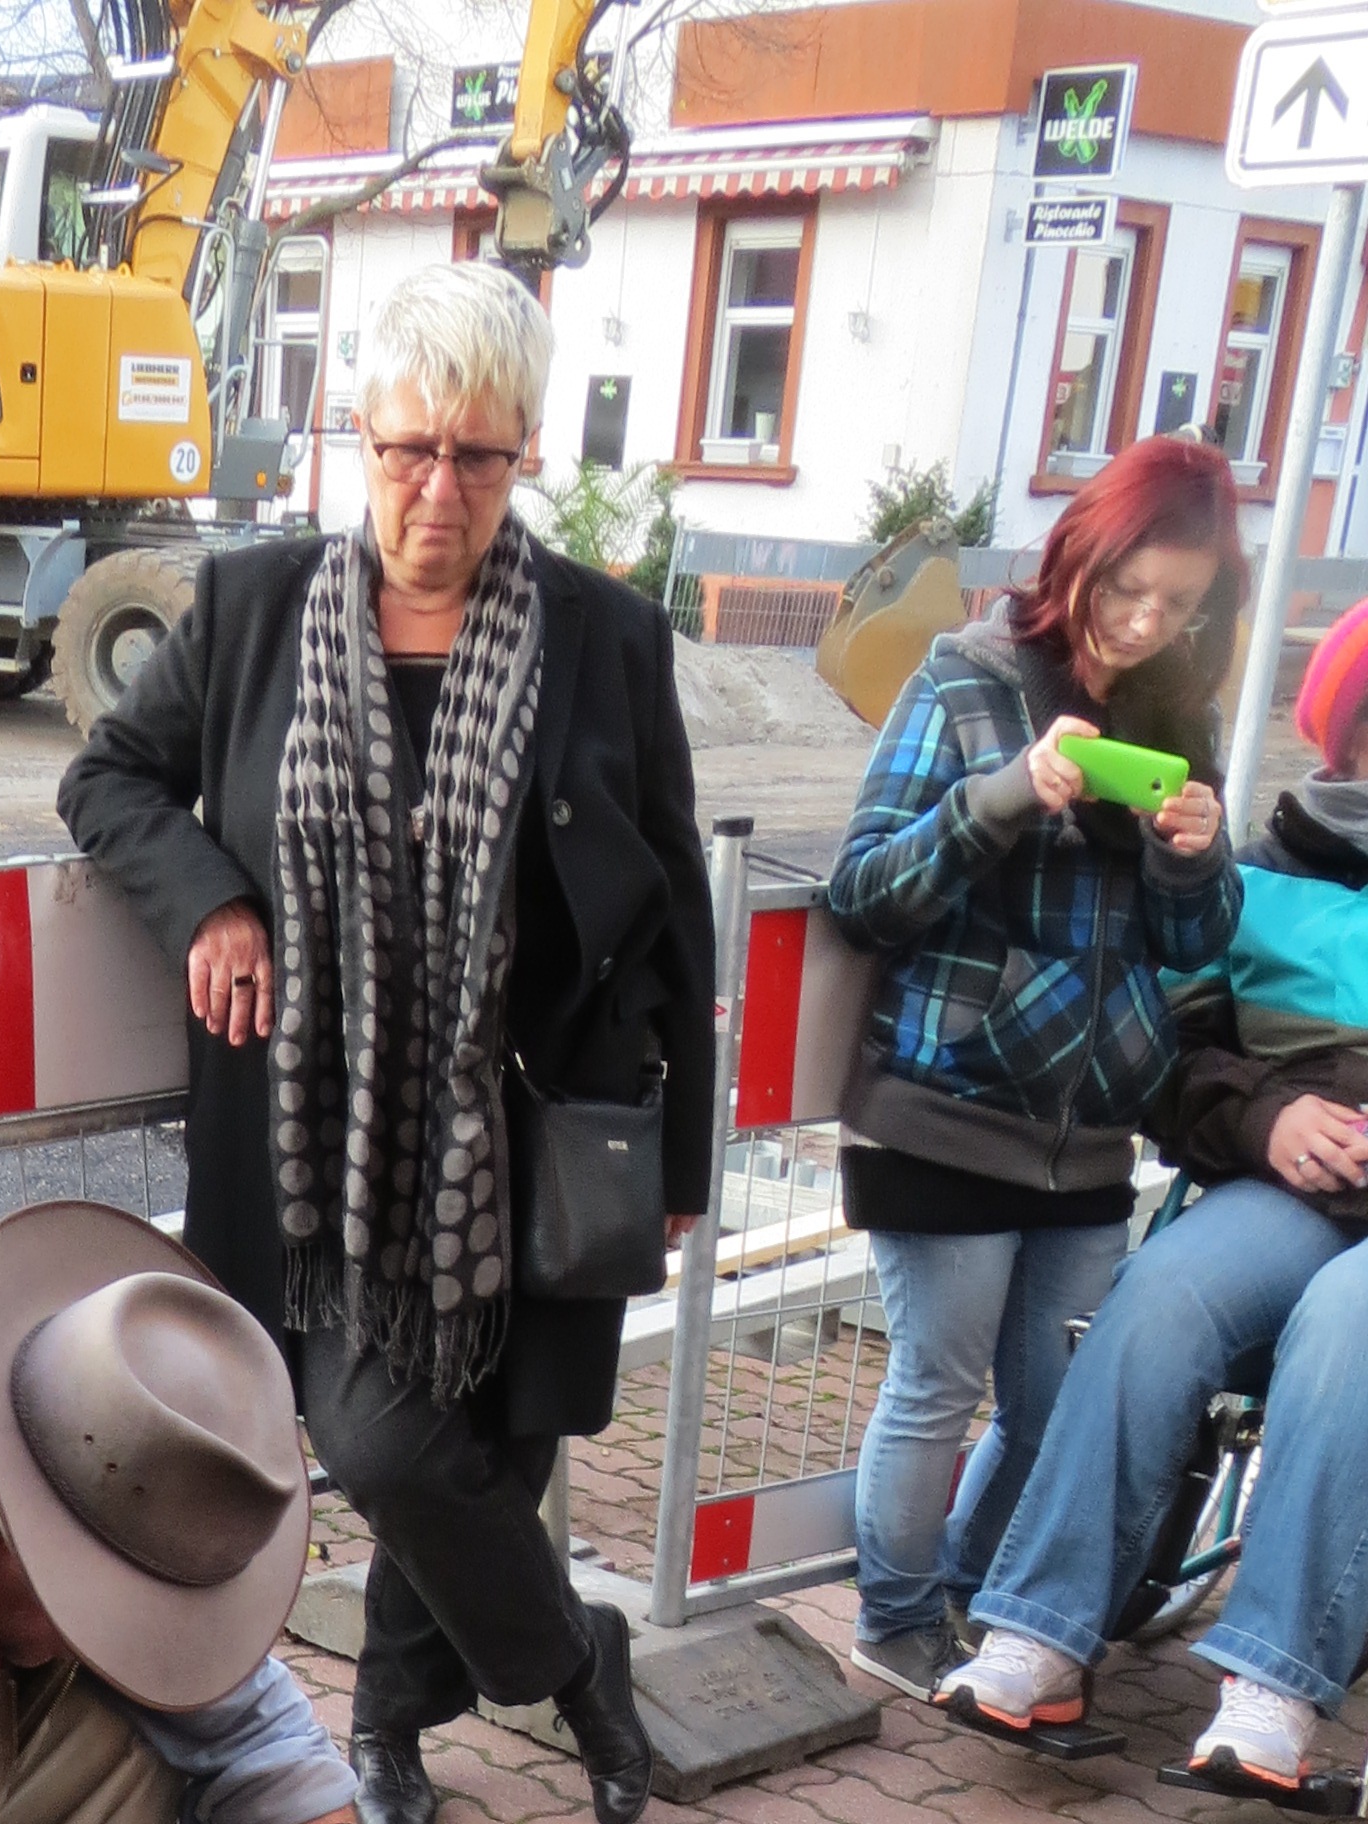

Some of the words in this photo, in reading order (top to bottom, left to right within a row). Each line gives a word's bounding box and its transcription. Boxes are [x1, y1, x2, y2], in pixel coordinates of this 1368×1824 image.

[1043, 117, 1115, 142] WELDE
[1032, 203, 1102, 221] Ristorante
[1034, 221, 1096, 239] Pinocchio
[176, 447, 196, 474] 20
